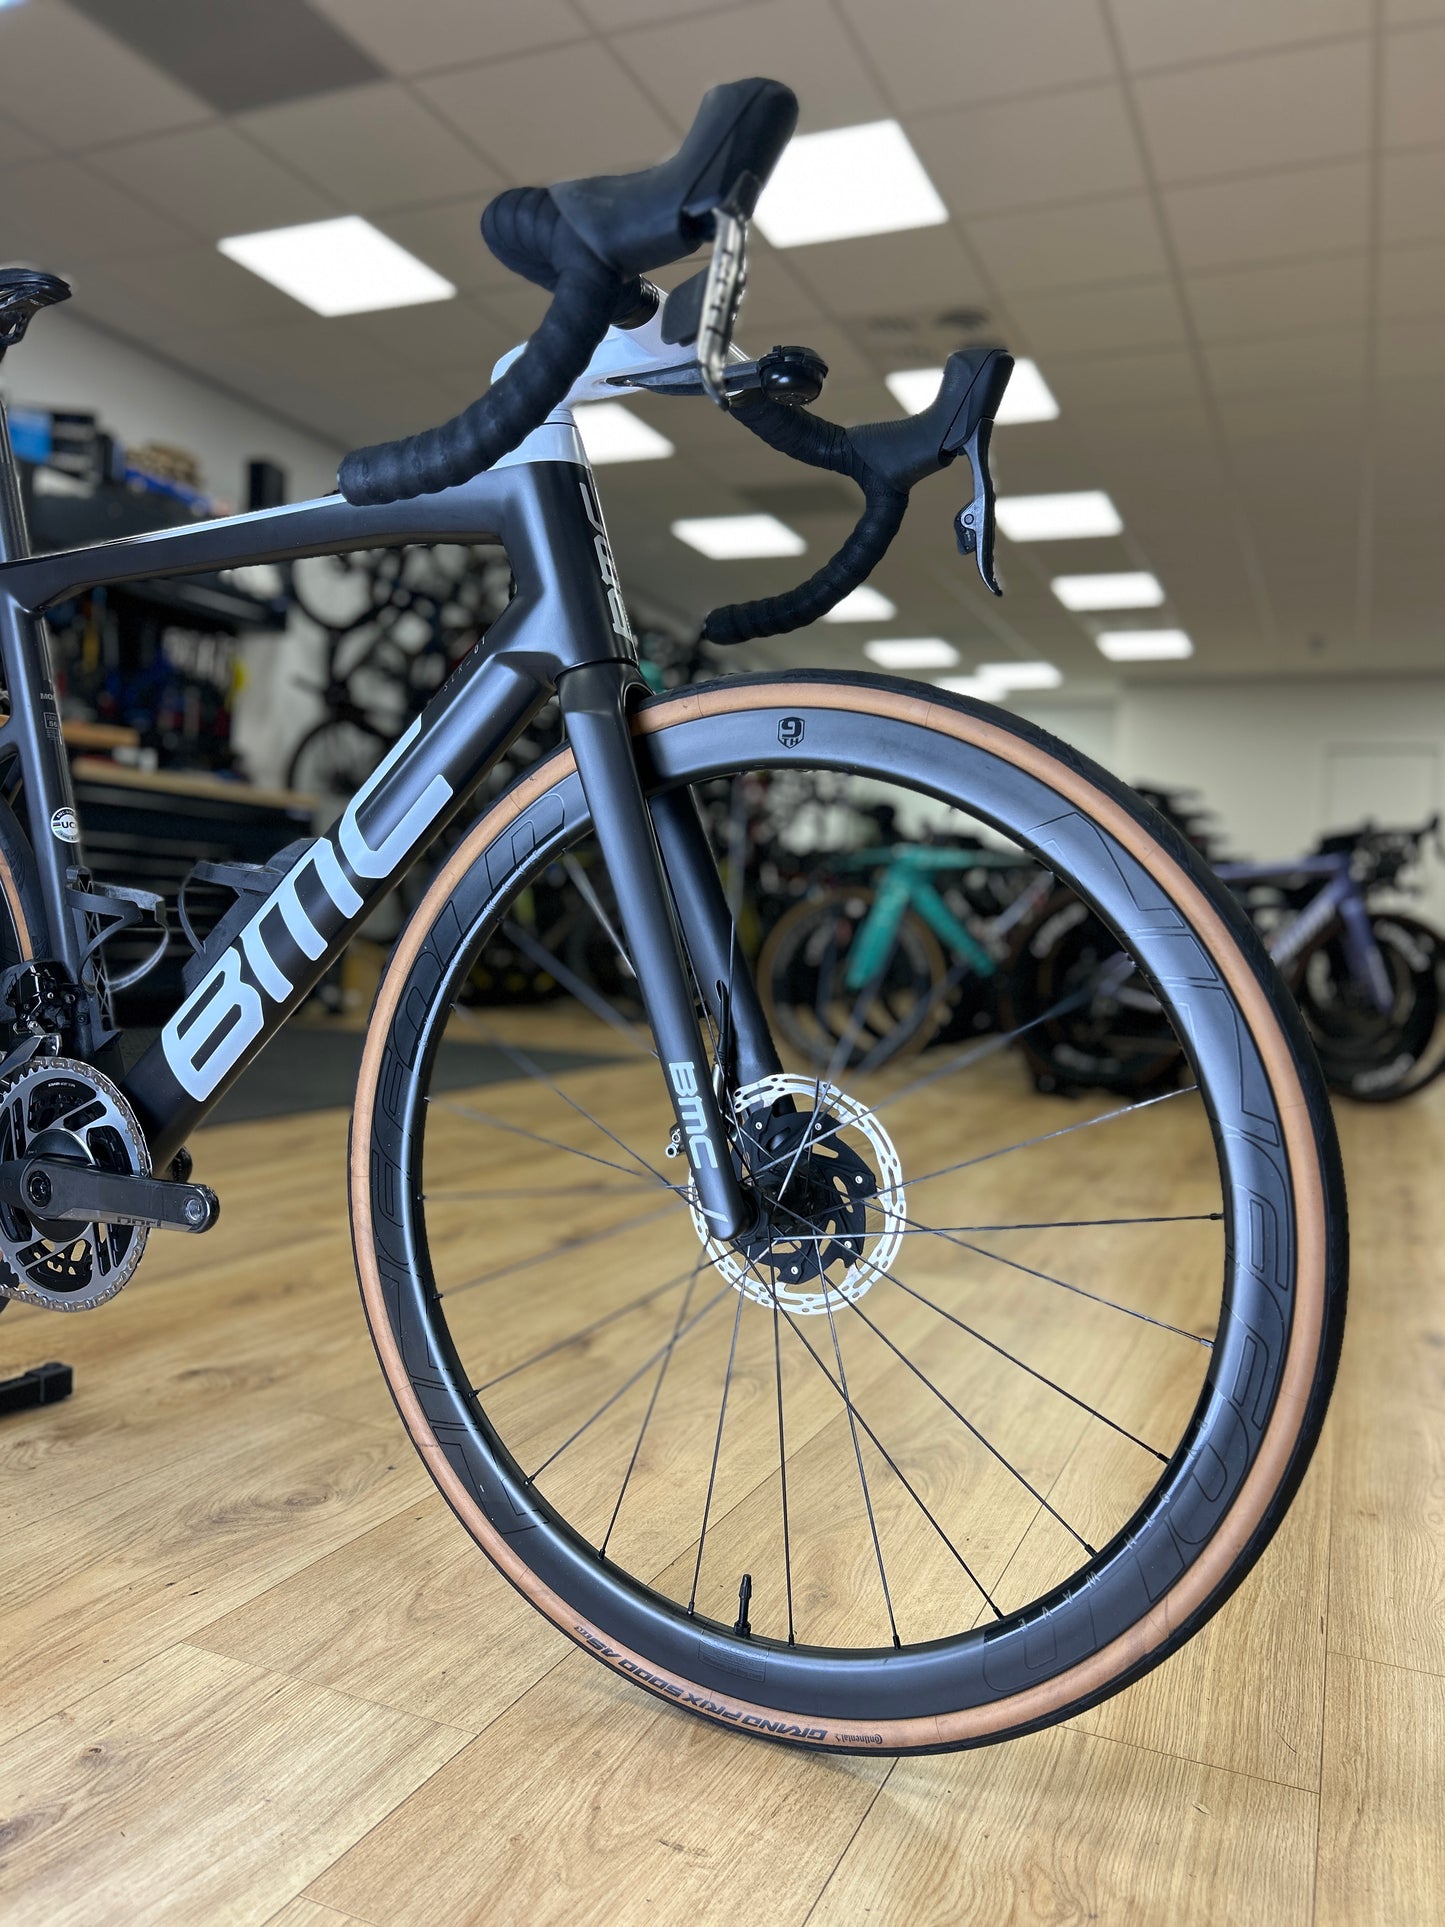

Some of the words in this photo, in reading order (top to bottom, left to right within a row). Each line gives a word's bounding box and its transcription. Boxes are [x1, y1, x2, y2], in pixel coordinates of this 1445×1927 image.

[161, 713, 454, 1102] BMC
[668, 1061, 718, 1169] BMC
[1017, 1570, 1100, 1631] WAVE
[618, 1658, 684, 1698] 5000
[682, 1692, 743, 1721] PRIX
[742, 1714, 828, 1741] GRAND
[842, 1733, 883, 1745] Continental
